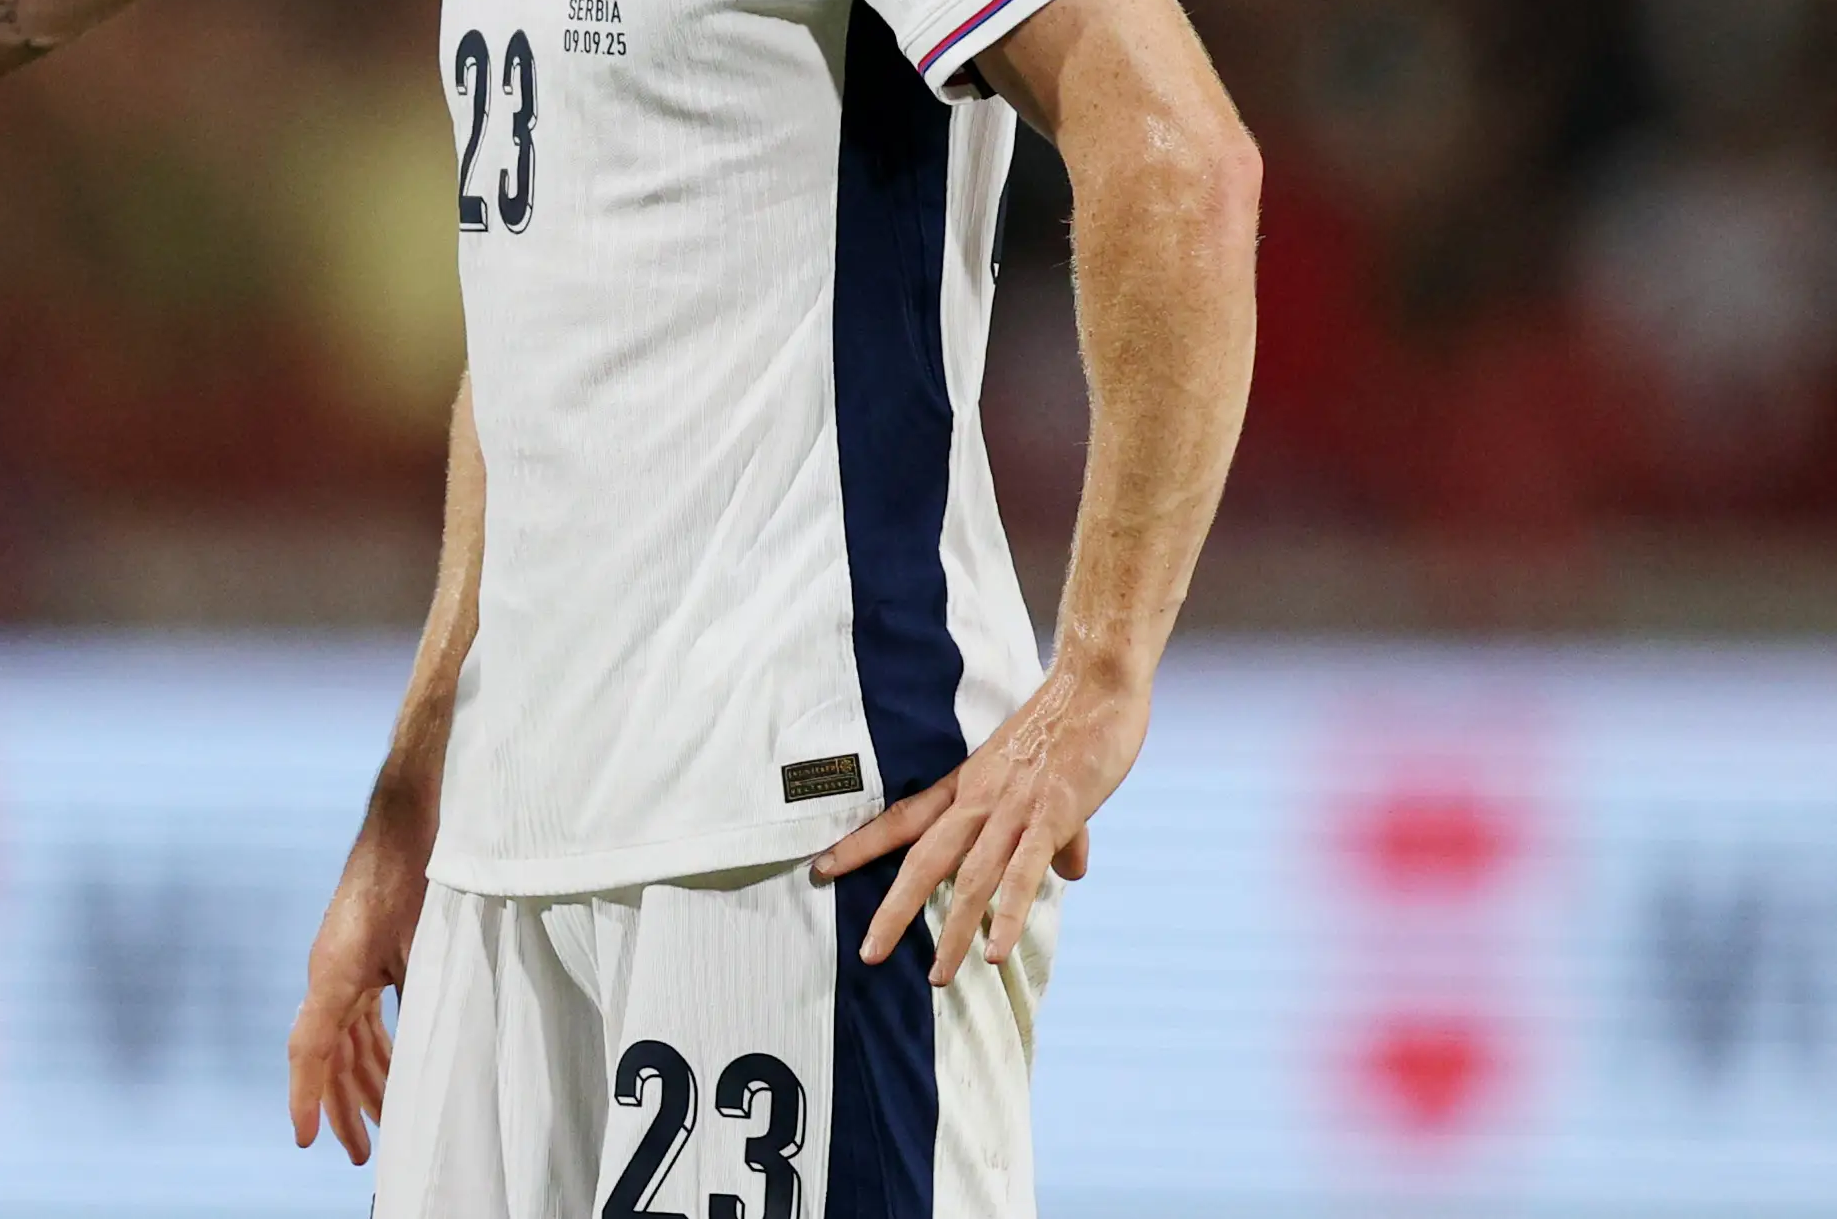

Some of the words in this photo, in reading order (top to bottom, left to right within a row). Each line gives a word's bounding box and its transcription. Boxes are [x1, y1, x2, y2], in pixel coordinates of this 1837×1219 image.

[455, 29, 537, 234] 23
[563, 29, 627, 56] 09.09.25
[602, 1039, 807, 1219] 23
